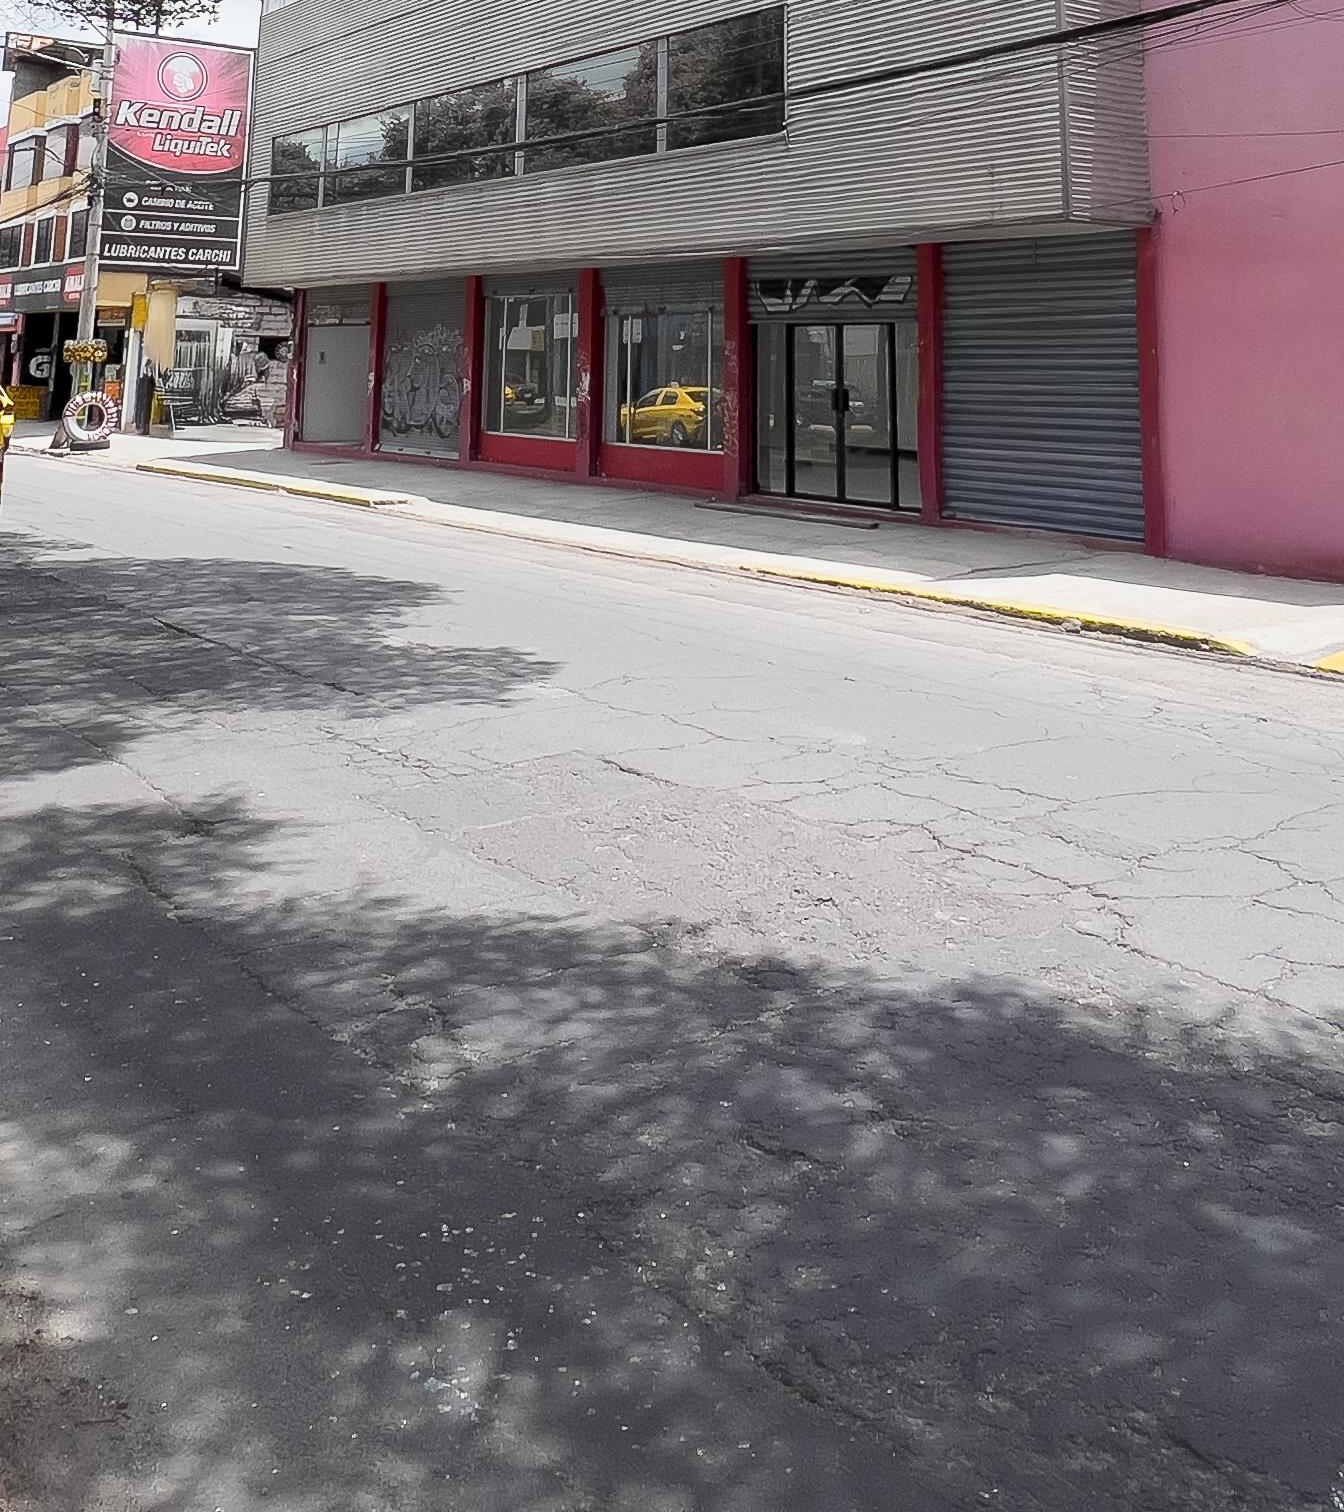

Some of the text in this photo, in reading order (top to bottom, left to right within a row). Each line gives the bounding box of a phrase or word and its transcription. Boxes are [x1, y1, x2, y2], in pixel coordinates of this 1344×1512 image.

[115, 99, 243, 137] Kendall
[152, 132, 232, 158] LiquiTek
[175, 199, 186, 209] DE
[139, 219, 216, 233] FILTROS Y ADITIVOS
[103, 243, 232, 263] LUBRICANTES CARCHI
